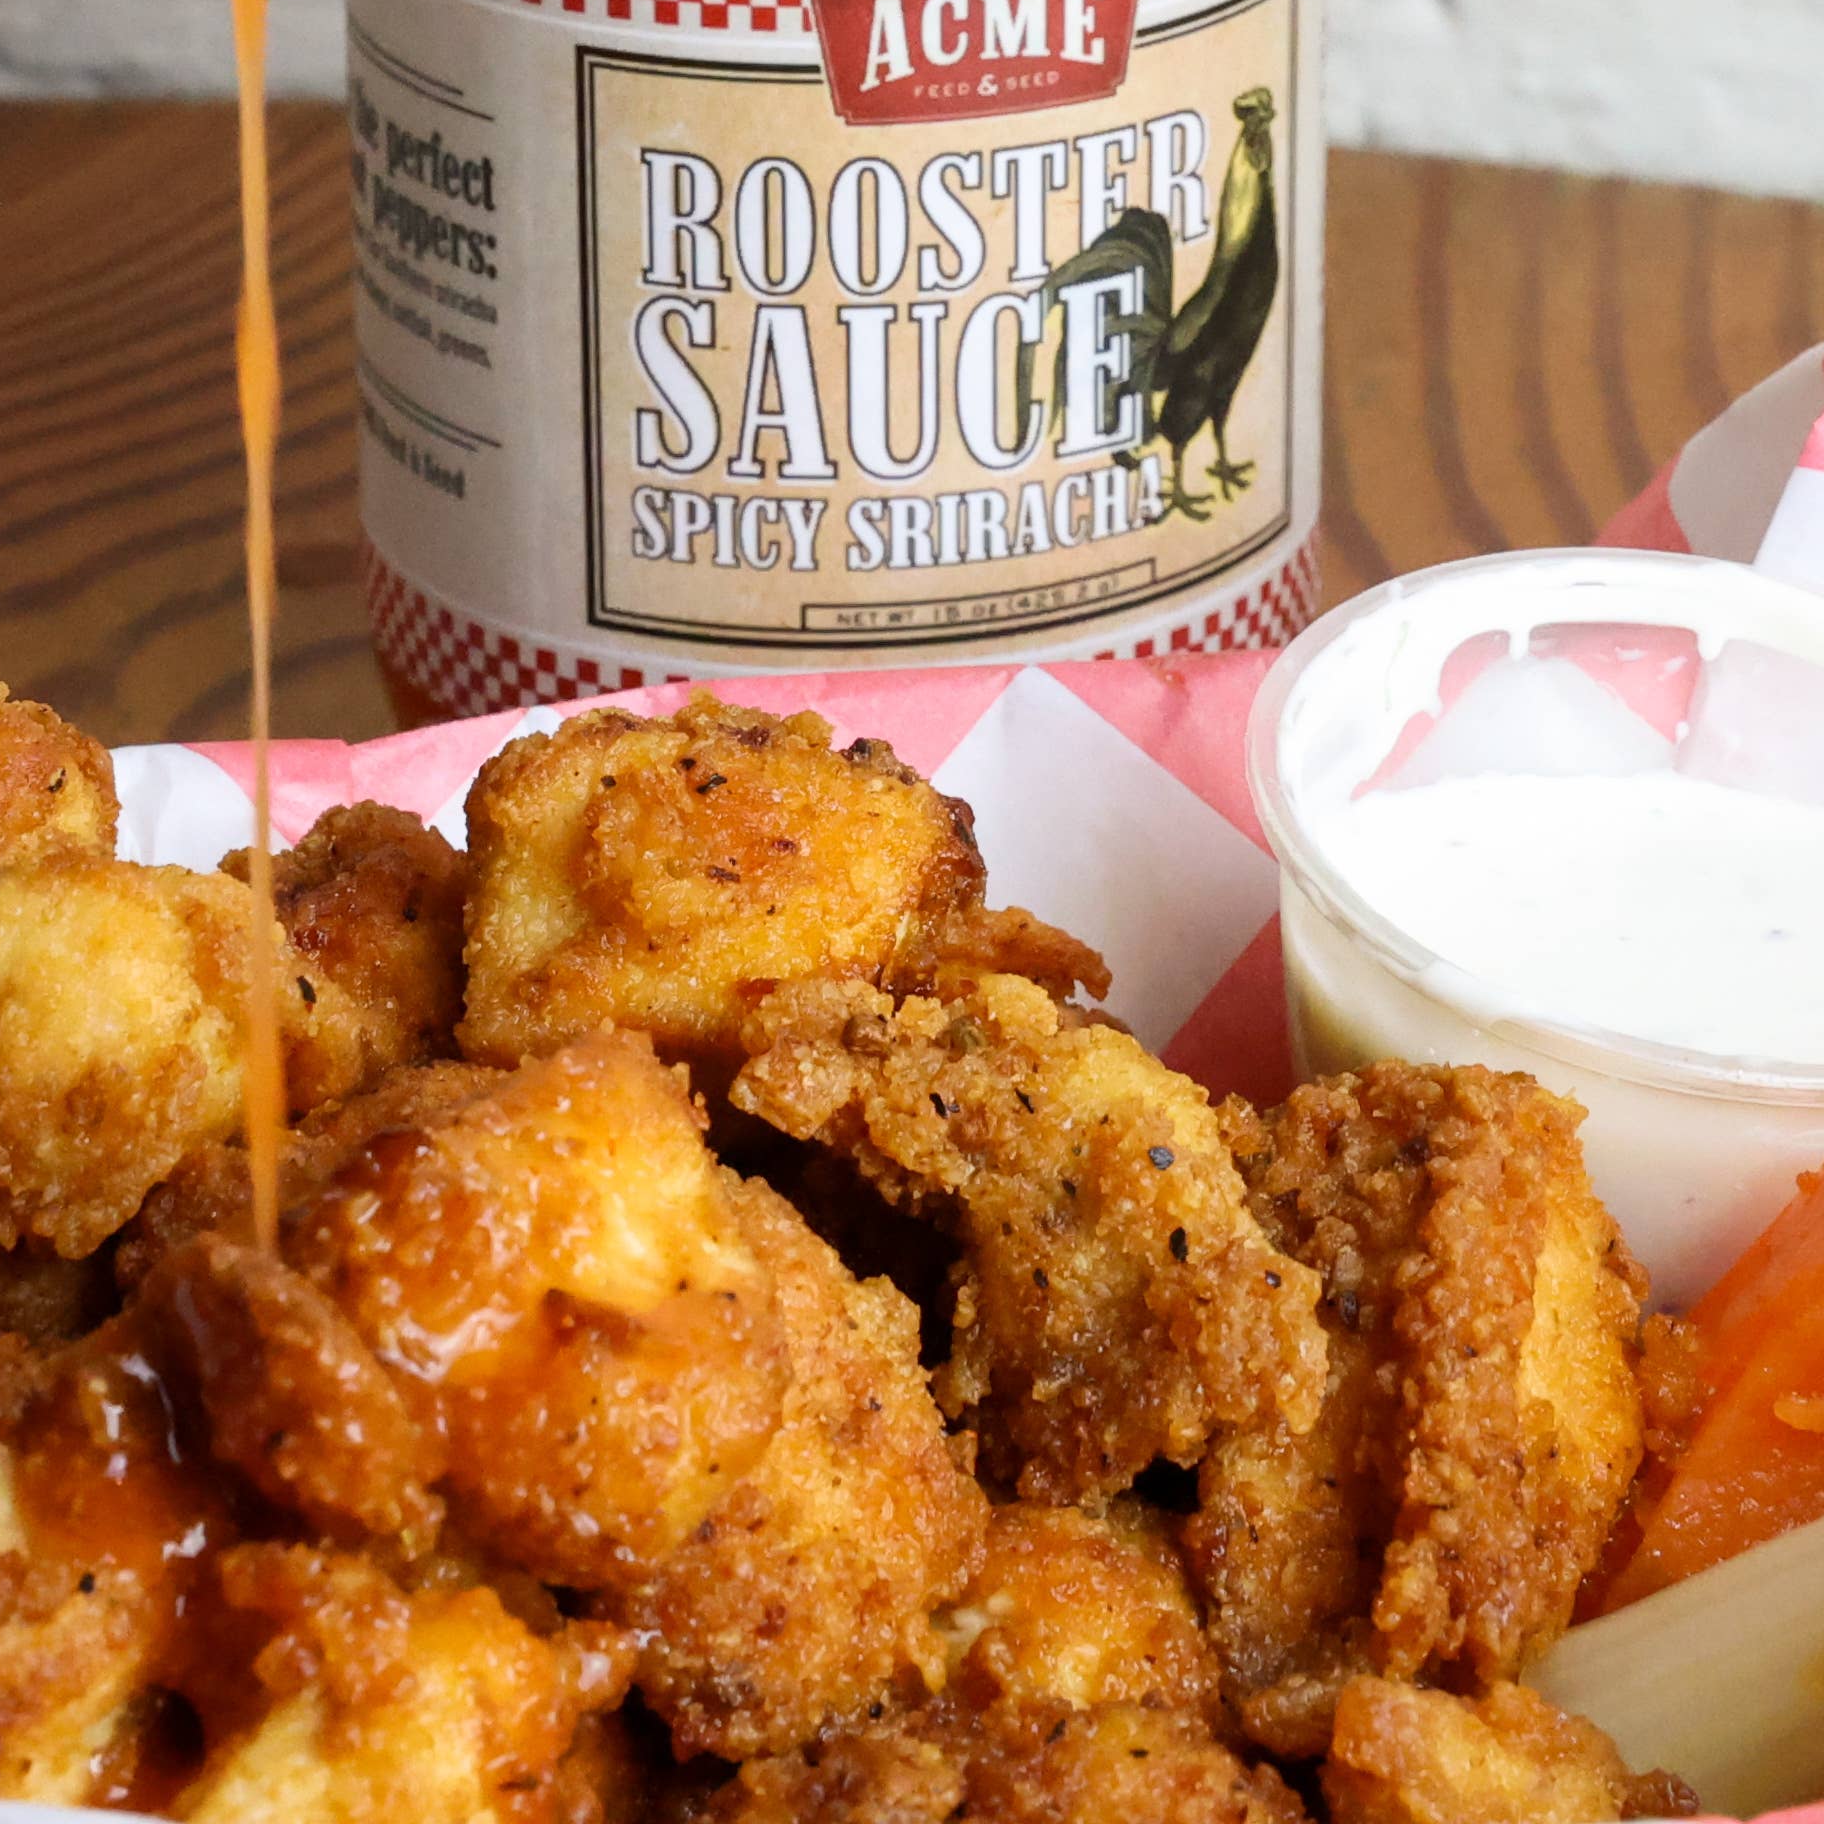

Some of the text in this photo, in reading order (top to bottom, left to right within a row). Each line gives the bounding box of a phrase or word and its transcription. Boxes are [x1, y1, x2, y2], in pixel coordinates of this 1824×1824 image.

[913, 70, 1060, 98] FEED & SEED
[385, 116, 496, 212] perfect
[640, 109, 1212, 296] ROOSTER
[373, 173, 498, 279] peppers:
[634, 266, 1146, 480] SAUCE
[632, 454, 1165, 572] SPICY SRIRACHA
[837, 611, 878, 626] NET
